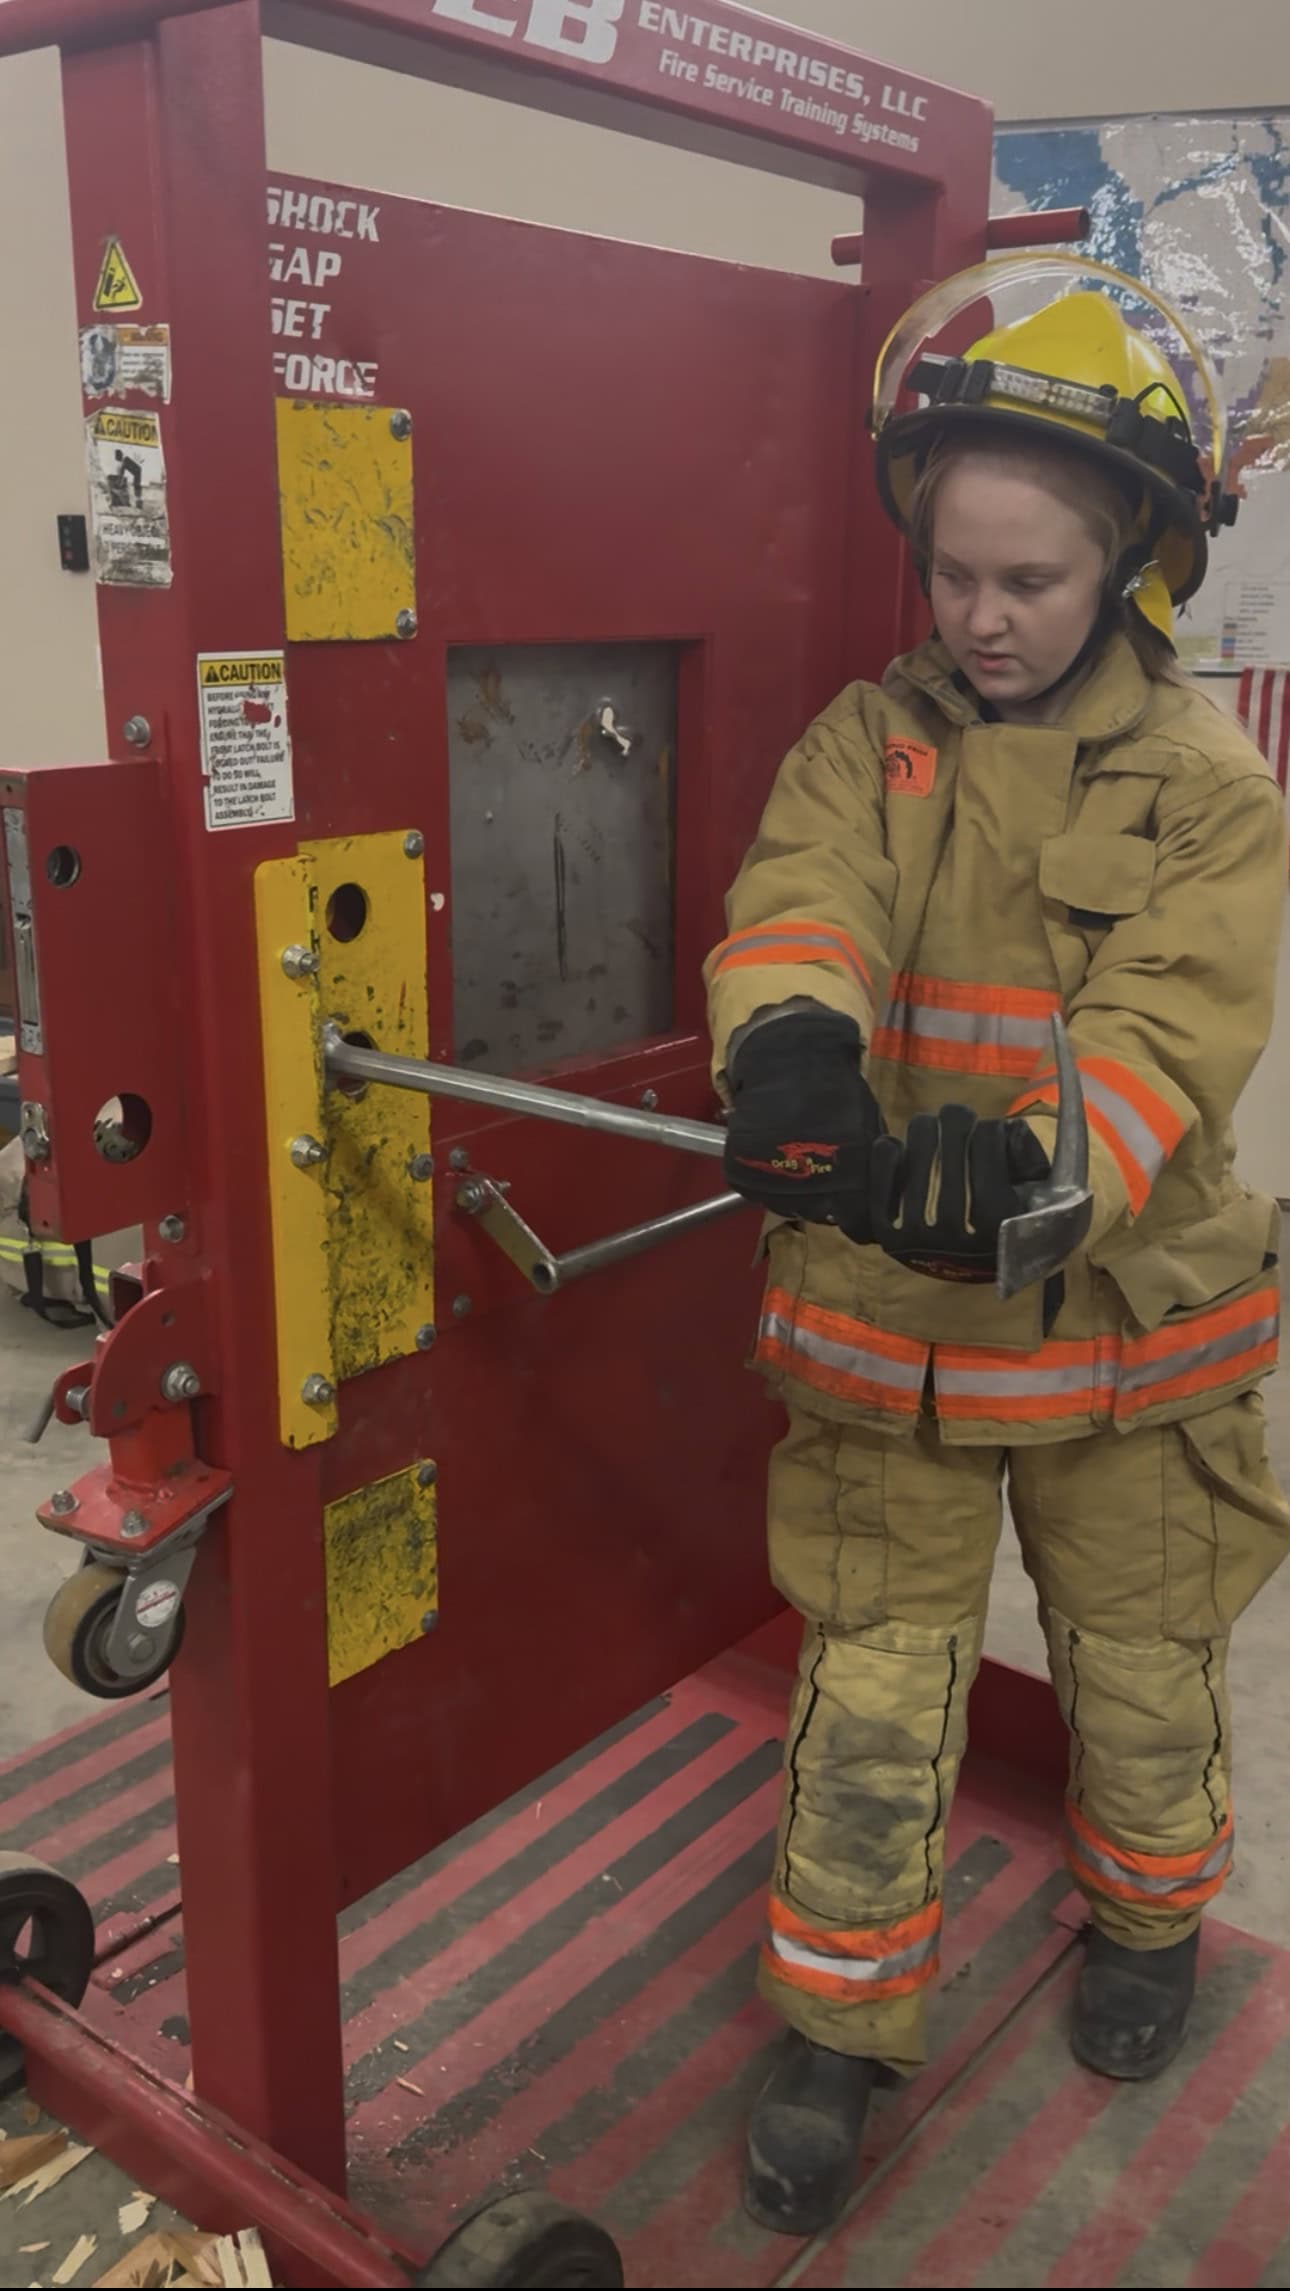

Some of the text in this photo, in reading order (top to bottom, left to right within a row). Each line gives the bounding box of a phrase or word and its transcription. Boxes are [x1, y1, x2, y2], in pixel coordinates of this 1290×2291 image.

[637, 1, 929, 121] ENTERPRISES, LLC
[658, 48, 920, 153] Fire Service Training Systems
[266, 186, 380, 242] SHOCK
[271, 297, 331, 340] SET
[272, 352, 379, 397] FORCE
[105, 417, 159, 442] CAUTION
[220, 662, 281, 682] CAUTION
[256, 741, 273, 752] BOLT
[248, 780, 276, 791] DAMAGE
